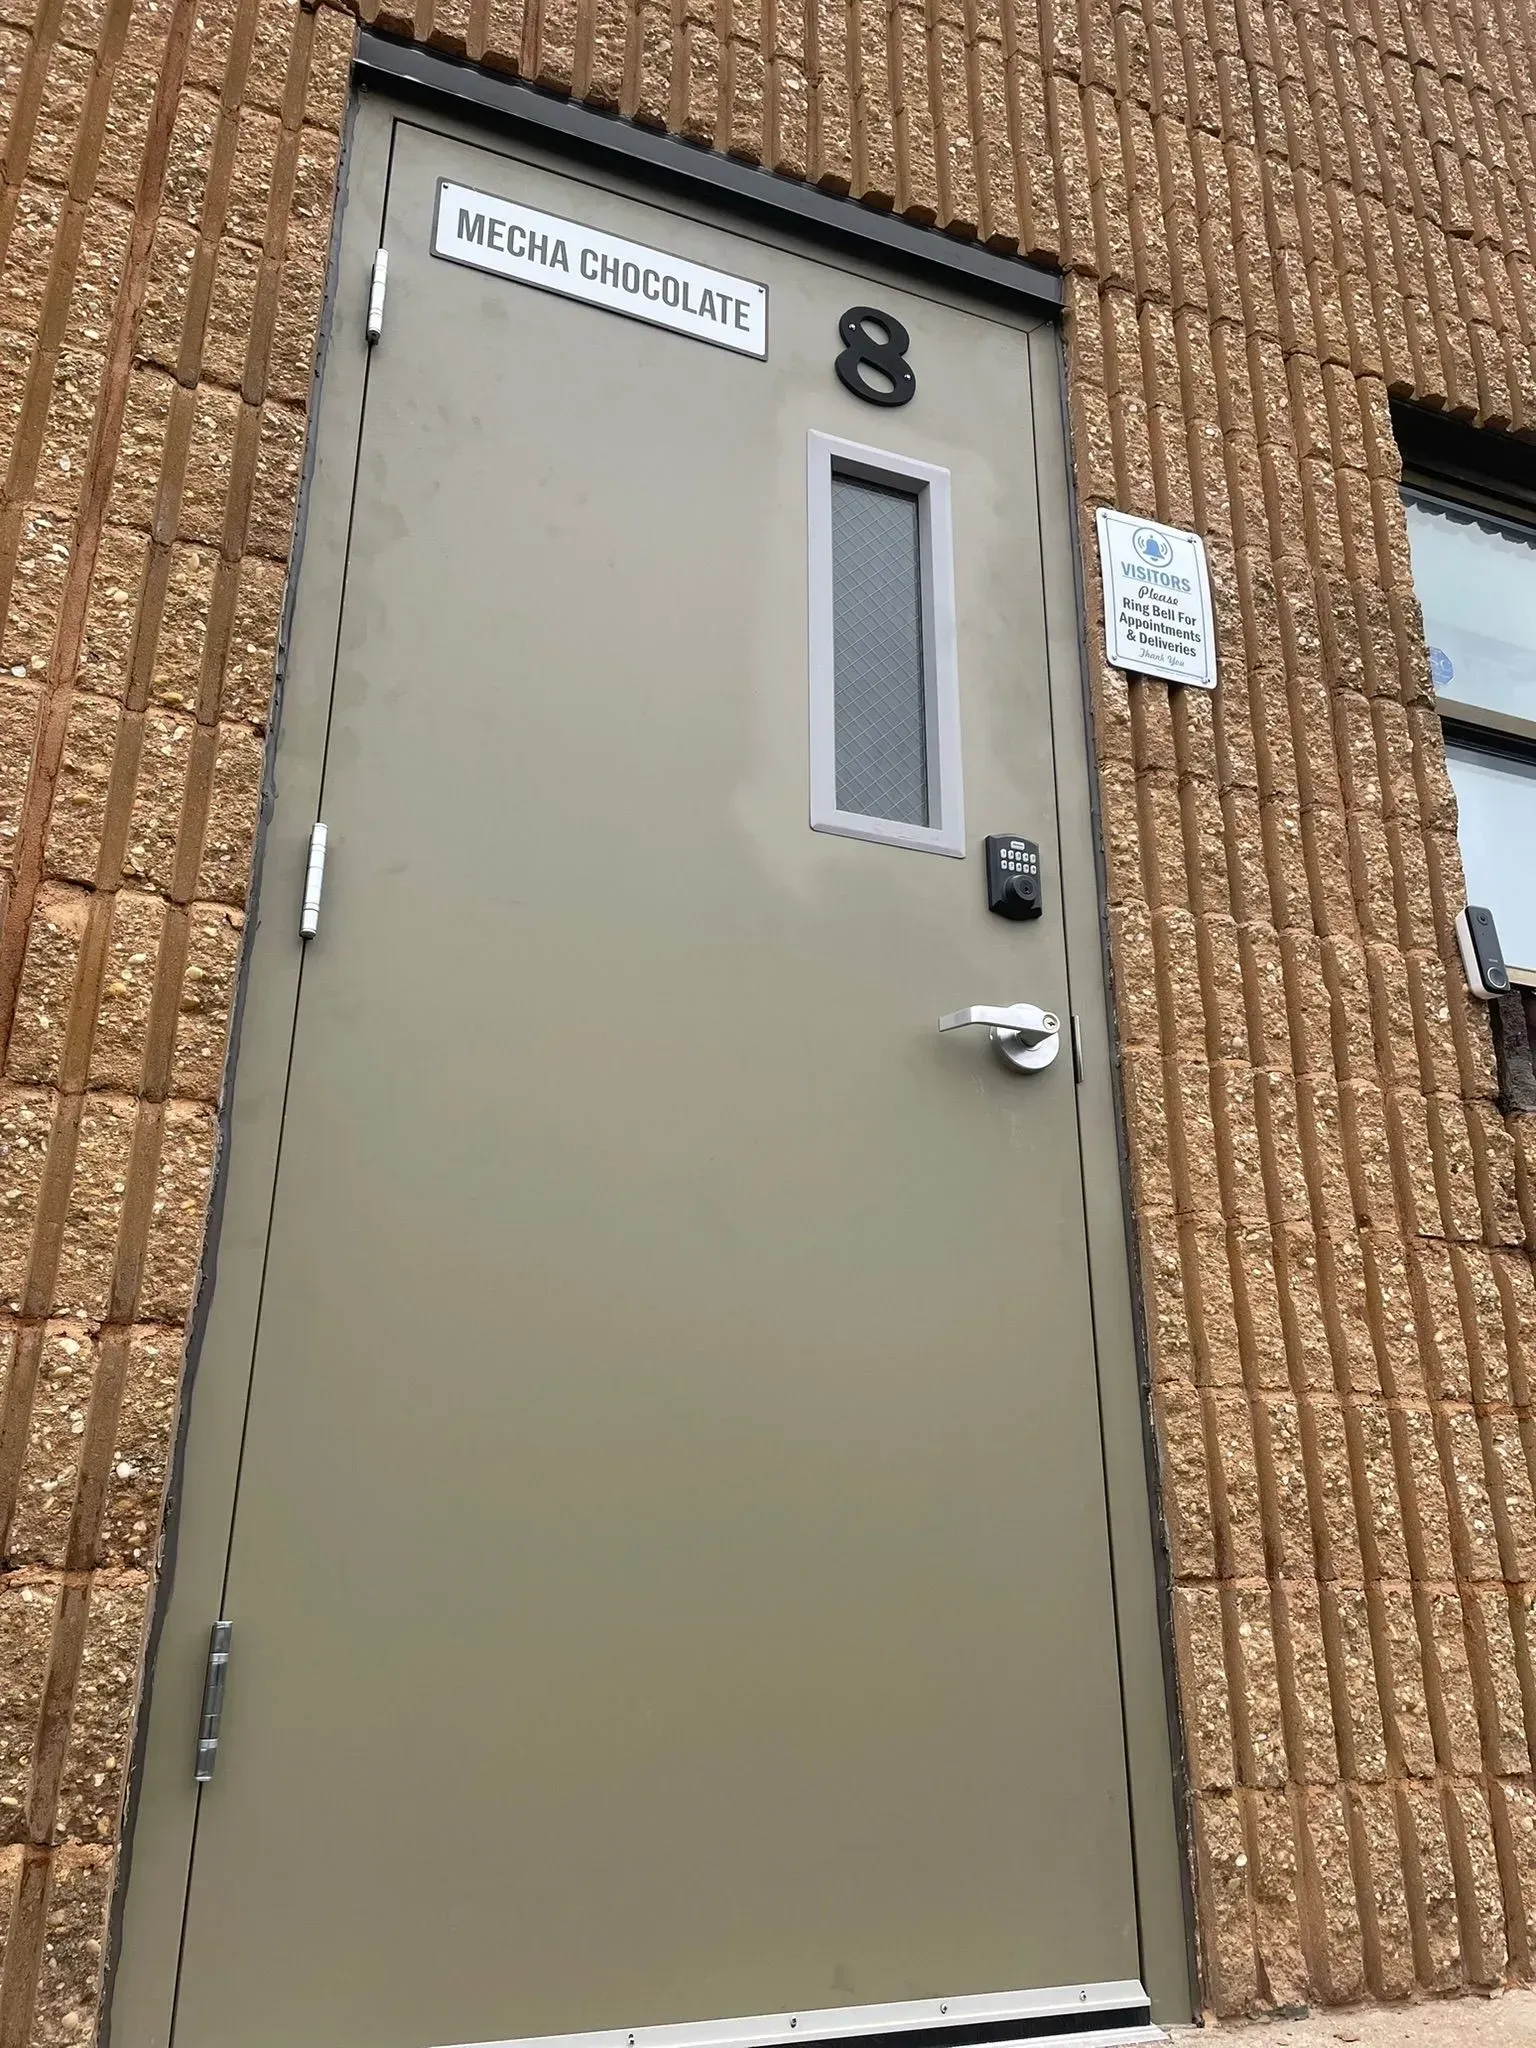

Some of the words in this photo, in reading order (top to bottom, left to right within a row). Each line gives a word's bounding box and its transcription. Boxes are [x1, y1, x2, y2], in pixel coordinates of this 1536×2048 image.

[457, 208, 569, 272] MECHA
[580, 248, 751, 332] CHOCOLATE
[835, 306, 916, 407] 8
[1121, 561, 1191, 592] VISITORS
[1138, 585, 1179, 606] Please
[1123, 597, 1150, 617] Ring
[1152, 605, 1175, 621] Bell
[1178, 611, 1197, 626] For
[1119, 611, 1201, 643] Appointments
[1126, 629, 1137, 642] &
[1139, 631, 1197, 657] Deliveries
[1139, 648, 1165, 662] Thank
[1167, 655, 1185, 667] You
